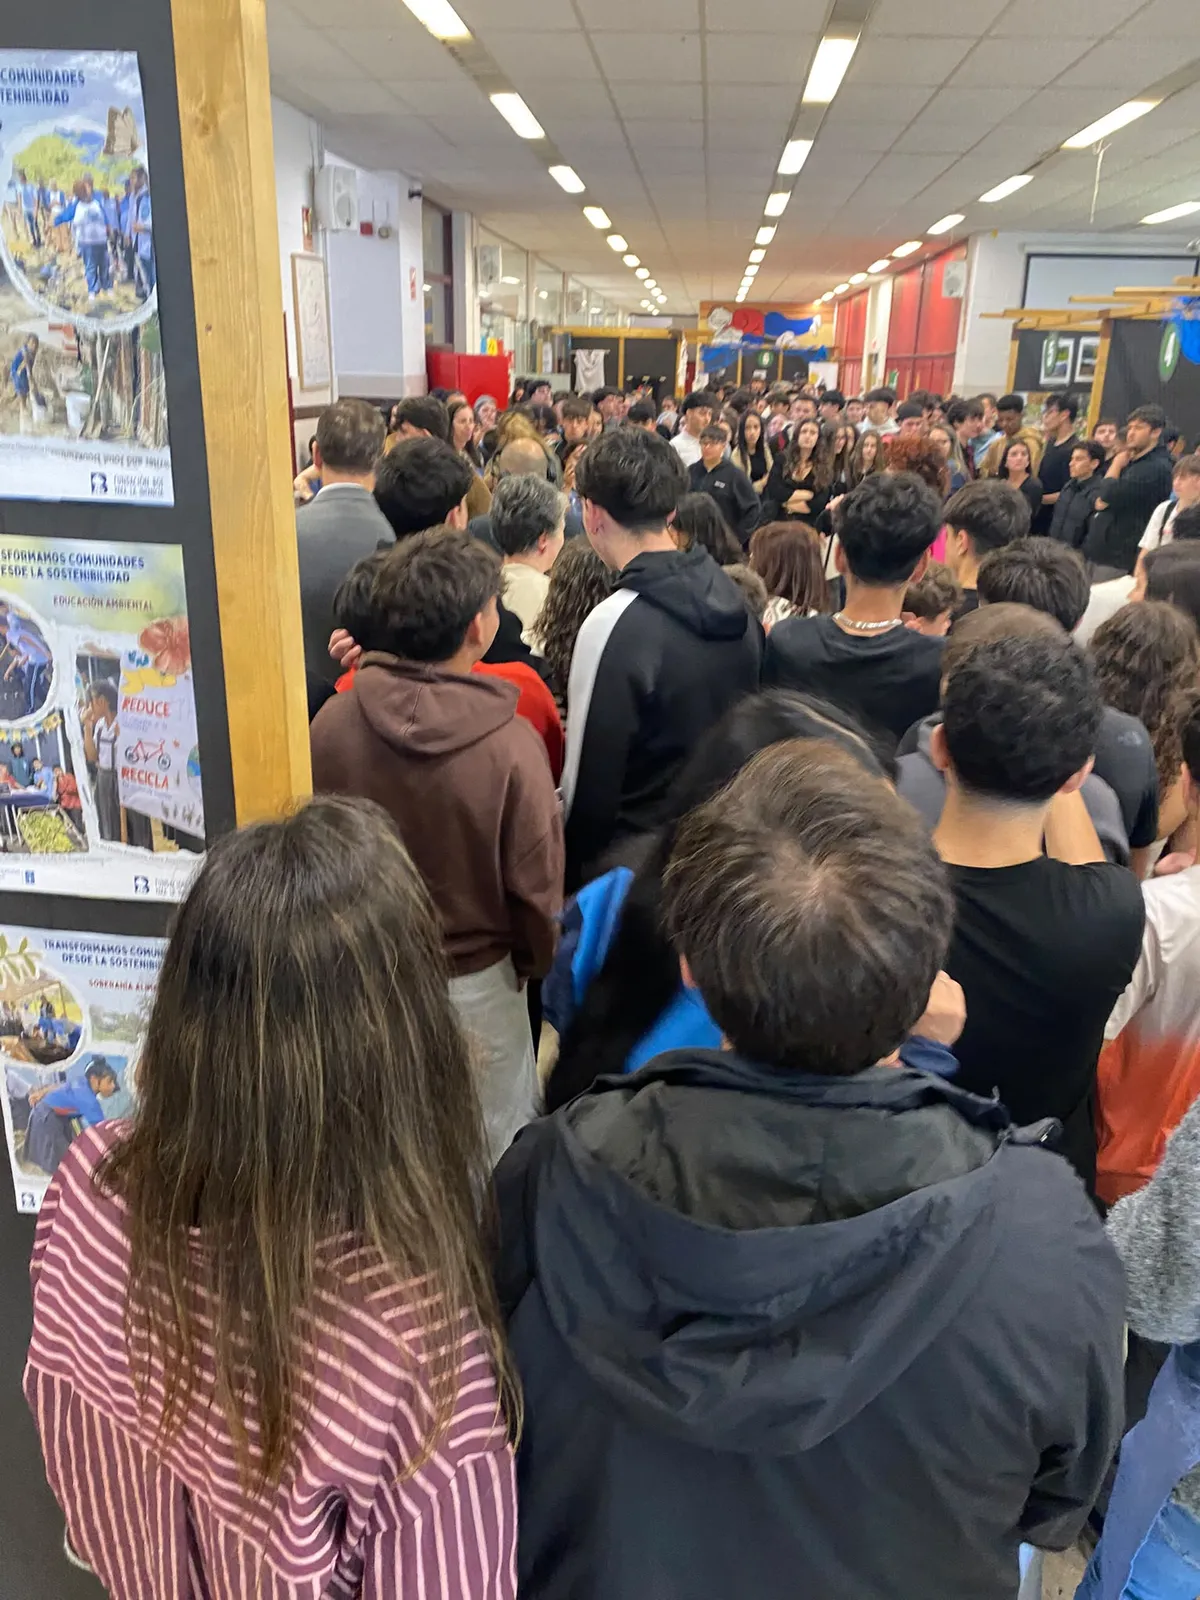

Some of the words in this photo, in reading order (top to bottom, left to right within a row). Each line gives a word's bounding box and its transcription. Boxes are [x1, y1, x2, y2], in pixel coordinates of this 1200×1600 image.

[0, 67, 85, 87] COMUNIDADES
[1164, 332, 1176, 367] 4
[1, 548, 66, 566] SFORMAMOS
[68, 552, 145, 570] COMUNIDADES
[0, 564, 27, 578] ESDE
[30, 566, 44, 579] LA
[46, 566, 131, 584] SOSTENIBILIDAD
[53, 594, 103, 608] EDUCACIÓN
[105, 598, 153, 611] AMBIENTAL
[121, 696, 170, 718] REDUCE
[121, 767, 169, 789] RECICLA
[44, 939, 127, 956] TRANSFORMAMOS
[129, 944, 164, 958] COMUN
[61, 952, 93, 965] DESDE
[95, 957, 108, 966] LA
[109, 958, 160, 971] SOSTENIBI
